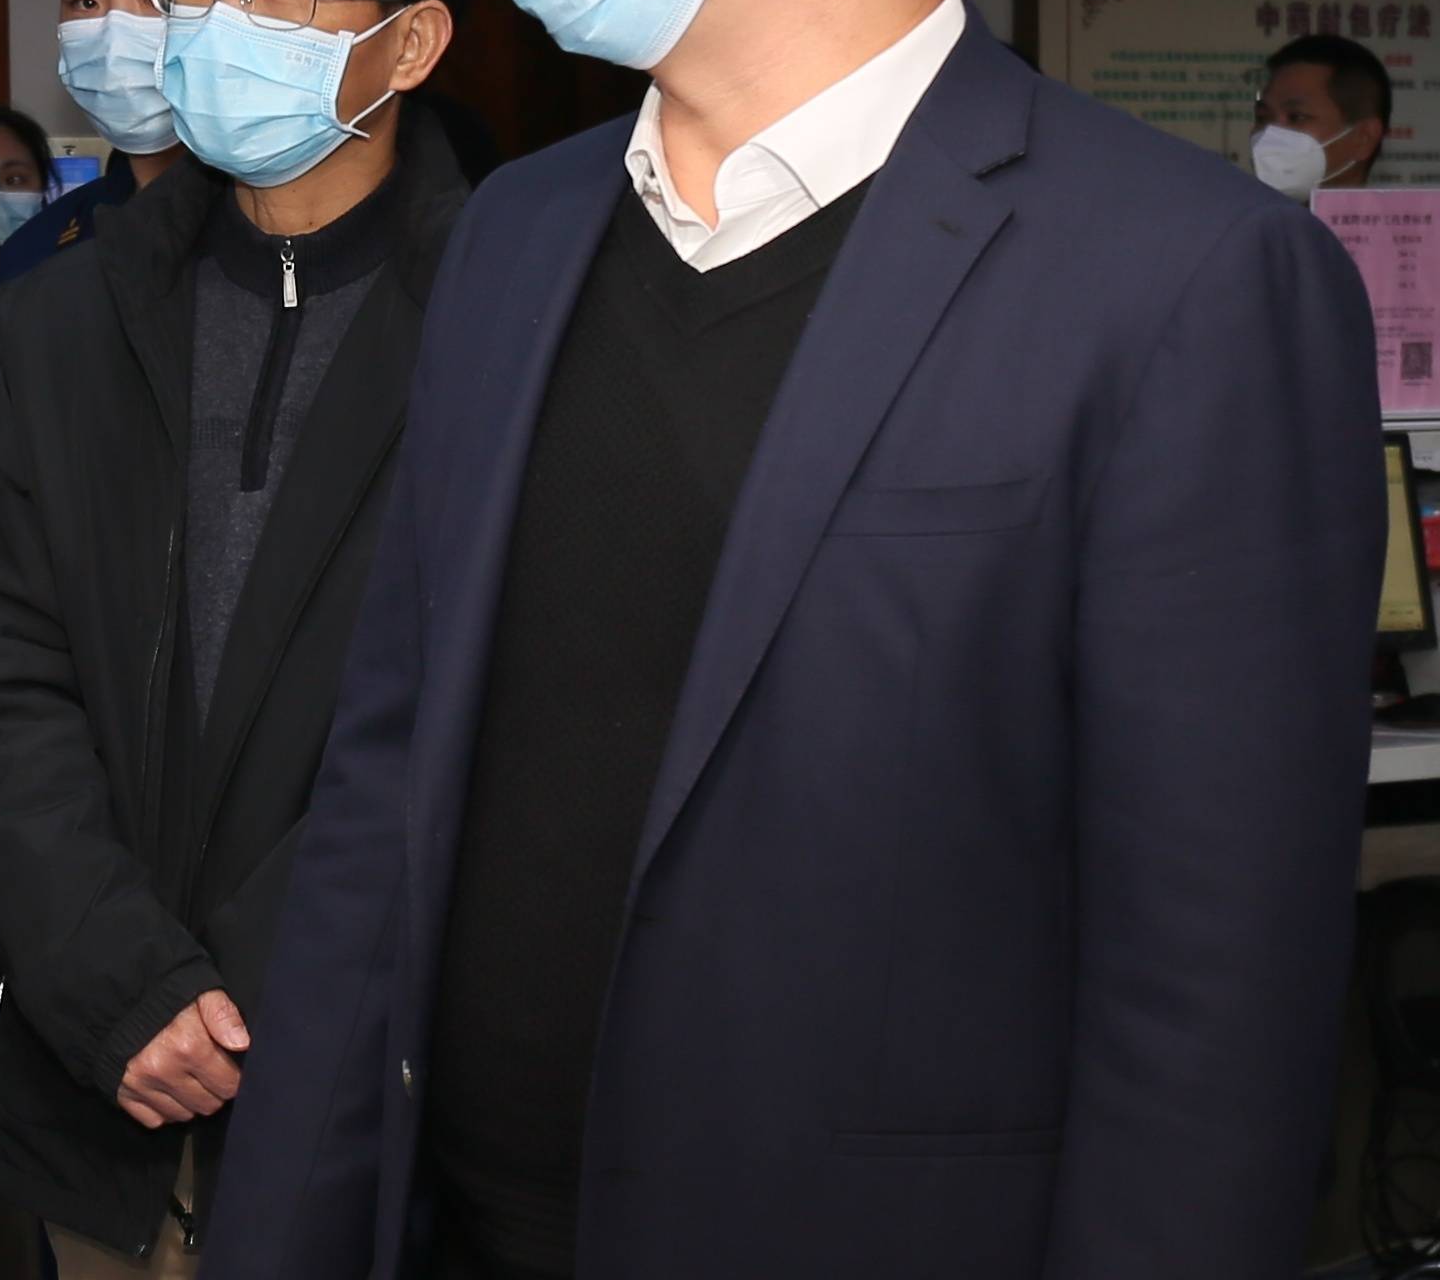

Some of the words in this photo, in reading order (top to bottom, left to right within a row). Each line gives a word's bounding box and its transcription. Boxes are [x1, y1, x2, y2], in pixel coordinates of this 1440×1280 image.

[1254, 0, 1432, 39] 中药封包疗法
